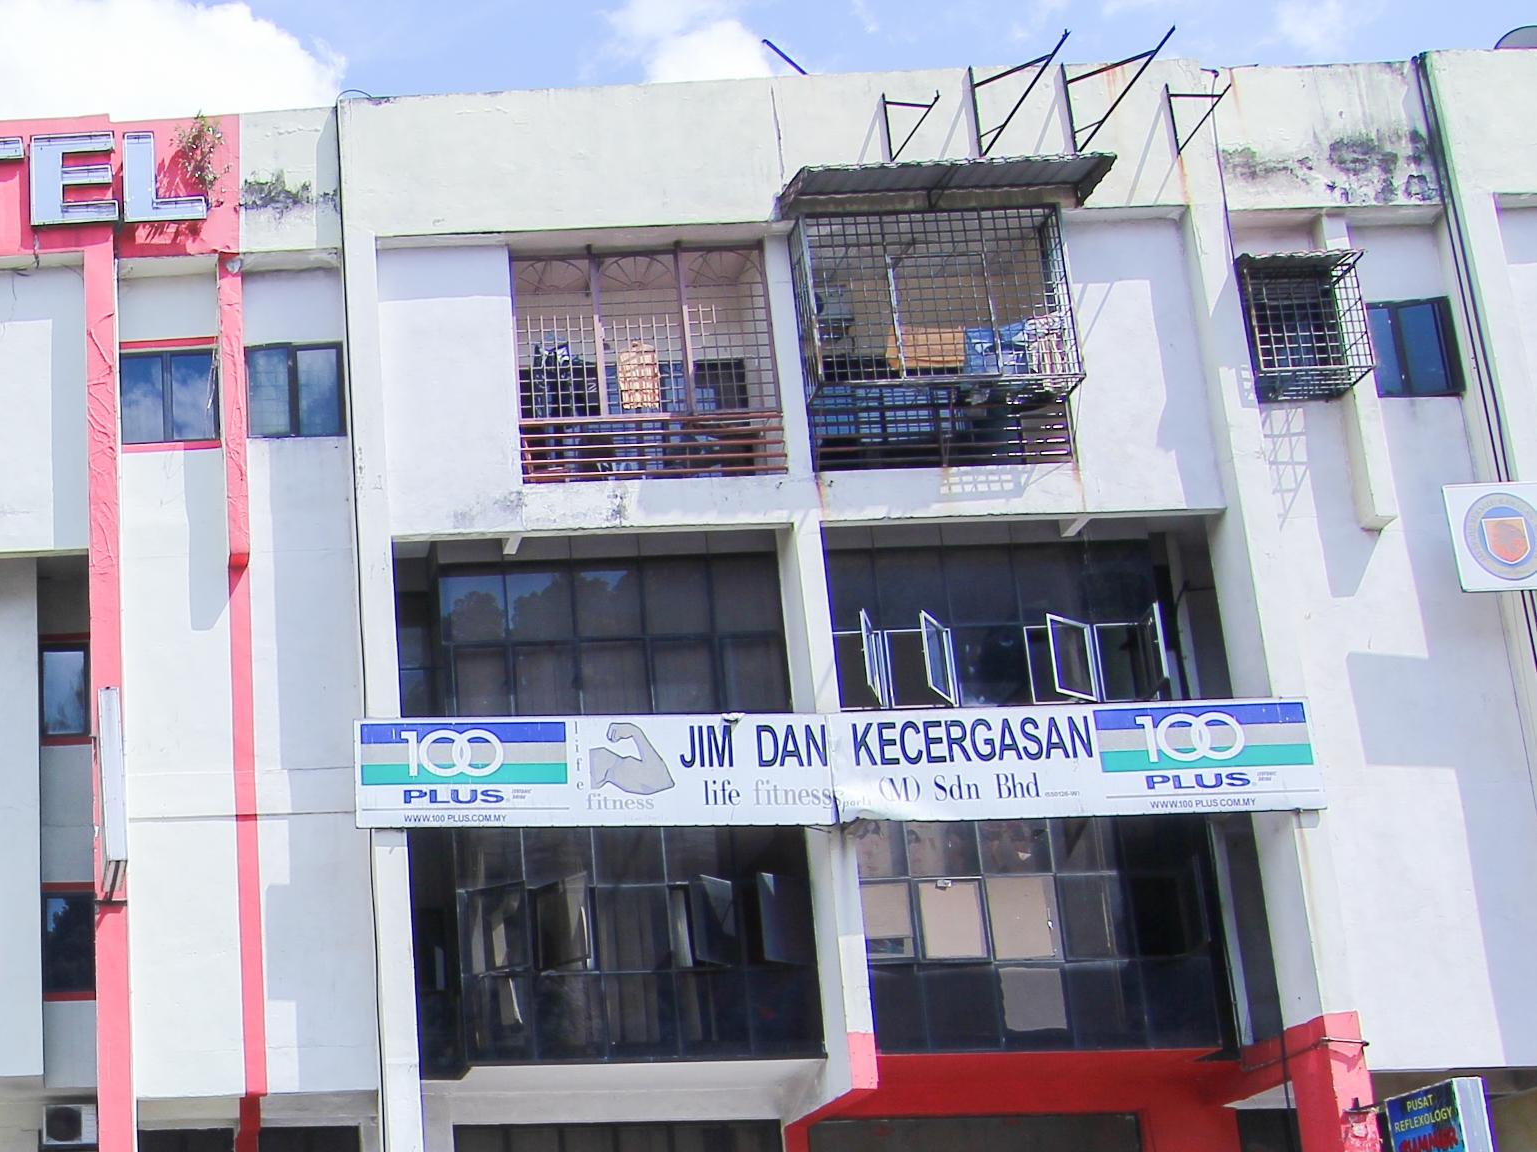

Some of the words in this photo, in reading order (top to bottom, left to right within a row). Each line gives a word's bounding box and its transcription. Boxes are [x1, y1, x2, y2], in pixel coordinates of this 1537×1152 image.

[680, 725, 733, 767] JIM
[756, 724, 827, 767] DAN
[852, 716, 1094, 766] KECERGASAN
[1135, 711, 1245, 762] 100
[400, 728, 504, 777] 100
[703, 780, 740, 805] life
[753, 780, 835, 806] fitness
[879, 775, 920, 802] (M)
[934, 774, 979, 800] Sdn
[994, 772, 1040, 799] Bhd
[1145, 772, 1251, 790] PLUS
[403, 789, 504, 804] PLUS
[586, 793, 654, 810] fitness
[1407, 1095, 1433, 1112] PUSAT
[1395, 1107, 1453, 1132] REFLEXOLOGY
